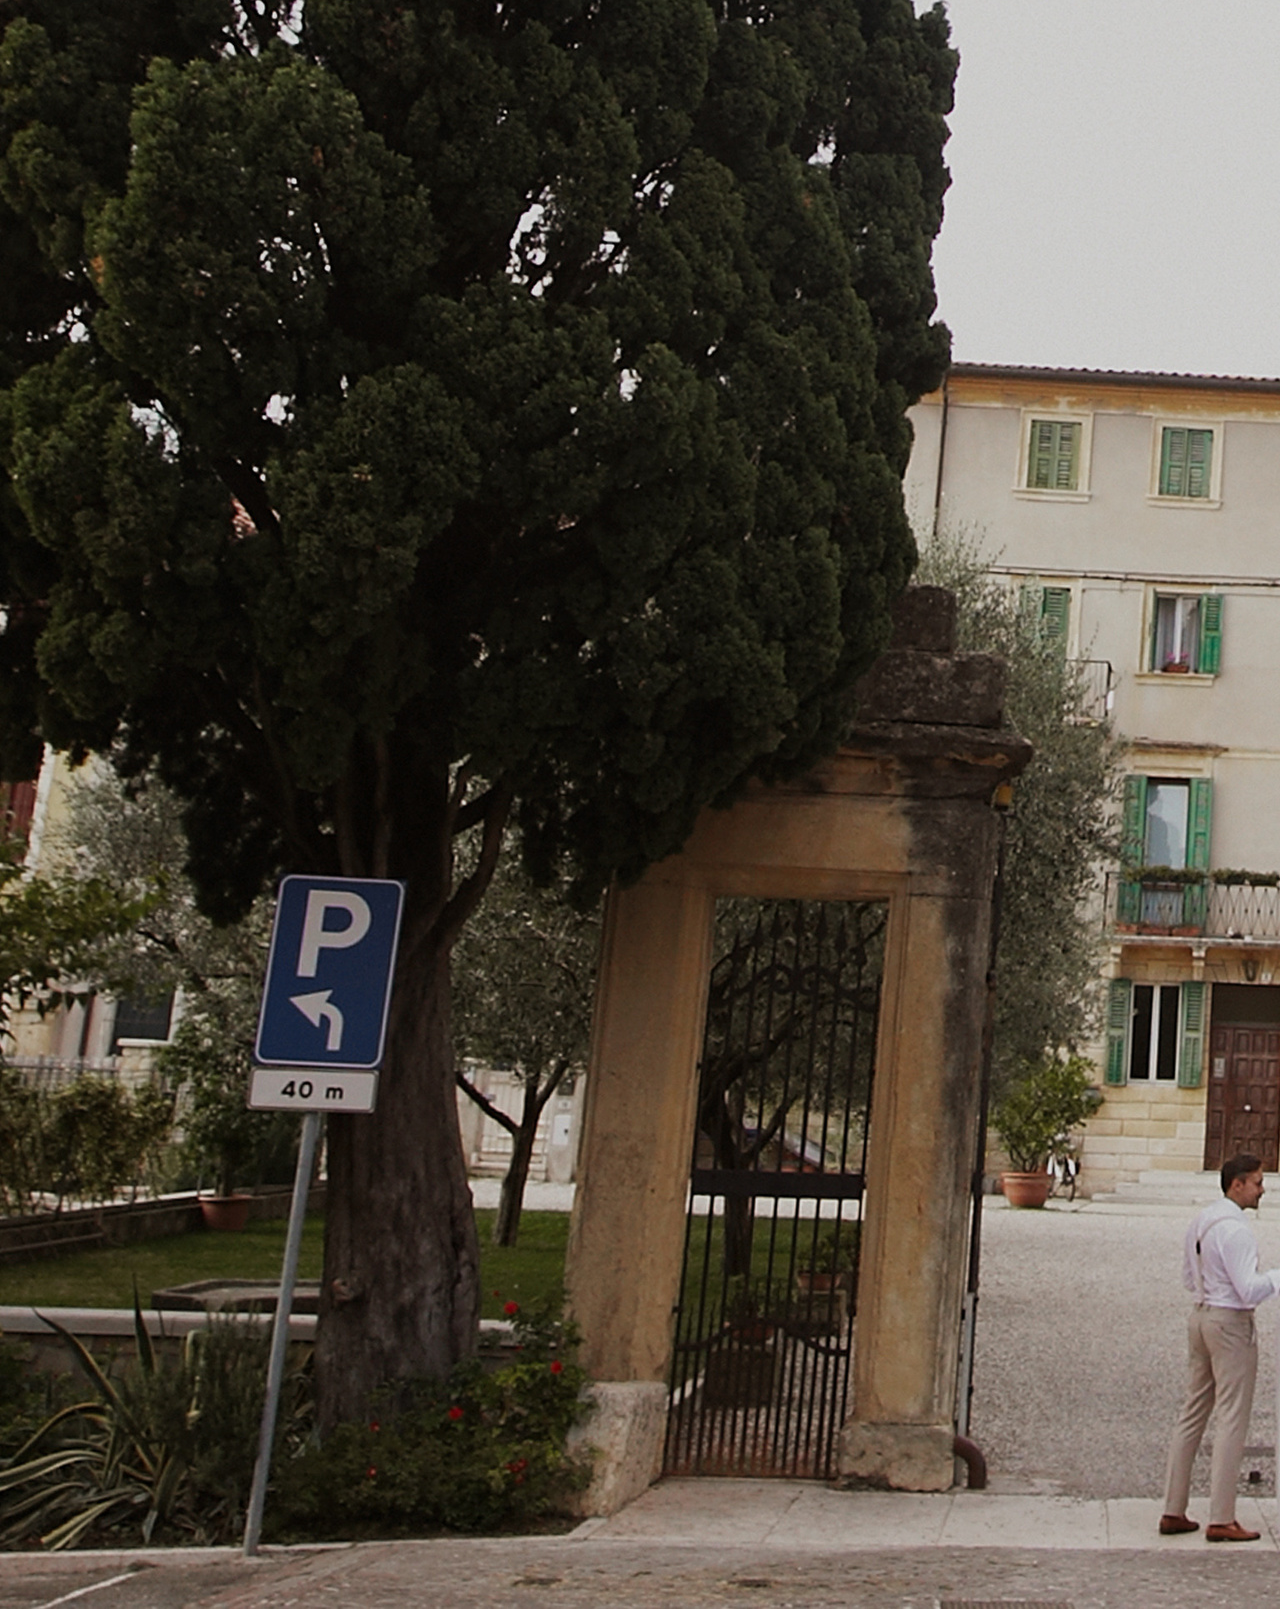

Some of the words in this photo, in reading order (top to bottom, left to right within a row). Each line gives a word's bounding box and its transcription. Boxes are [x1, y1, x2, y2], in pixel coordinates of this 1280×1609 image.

[297, 889, 371, 978] P
[281, 1080, 314, 1099] 40
[325, 1086, 344, 1100] m
